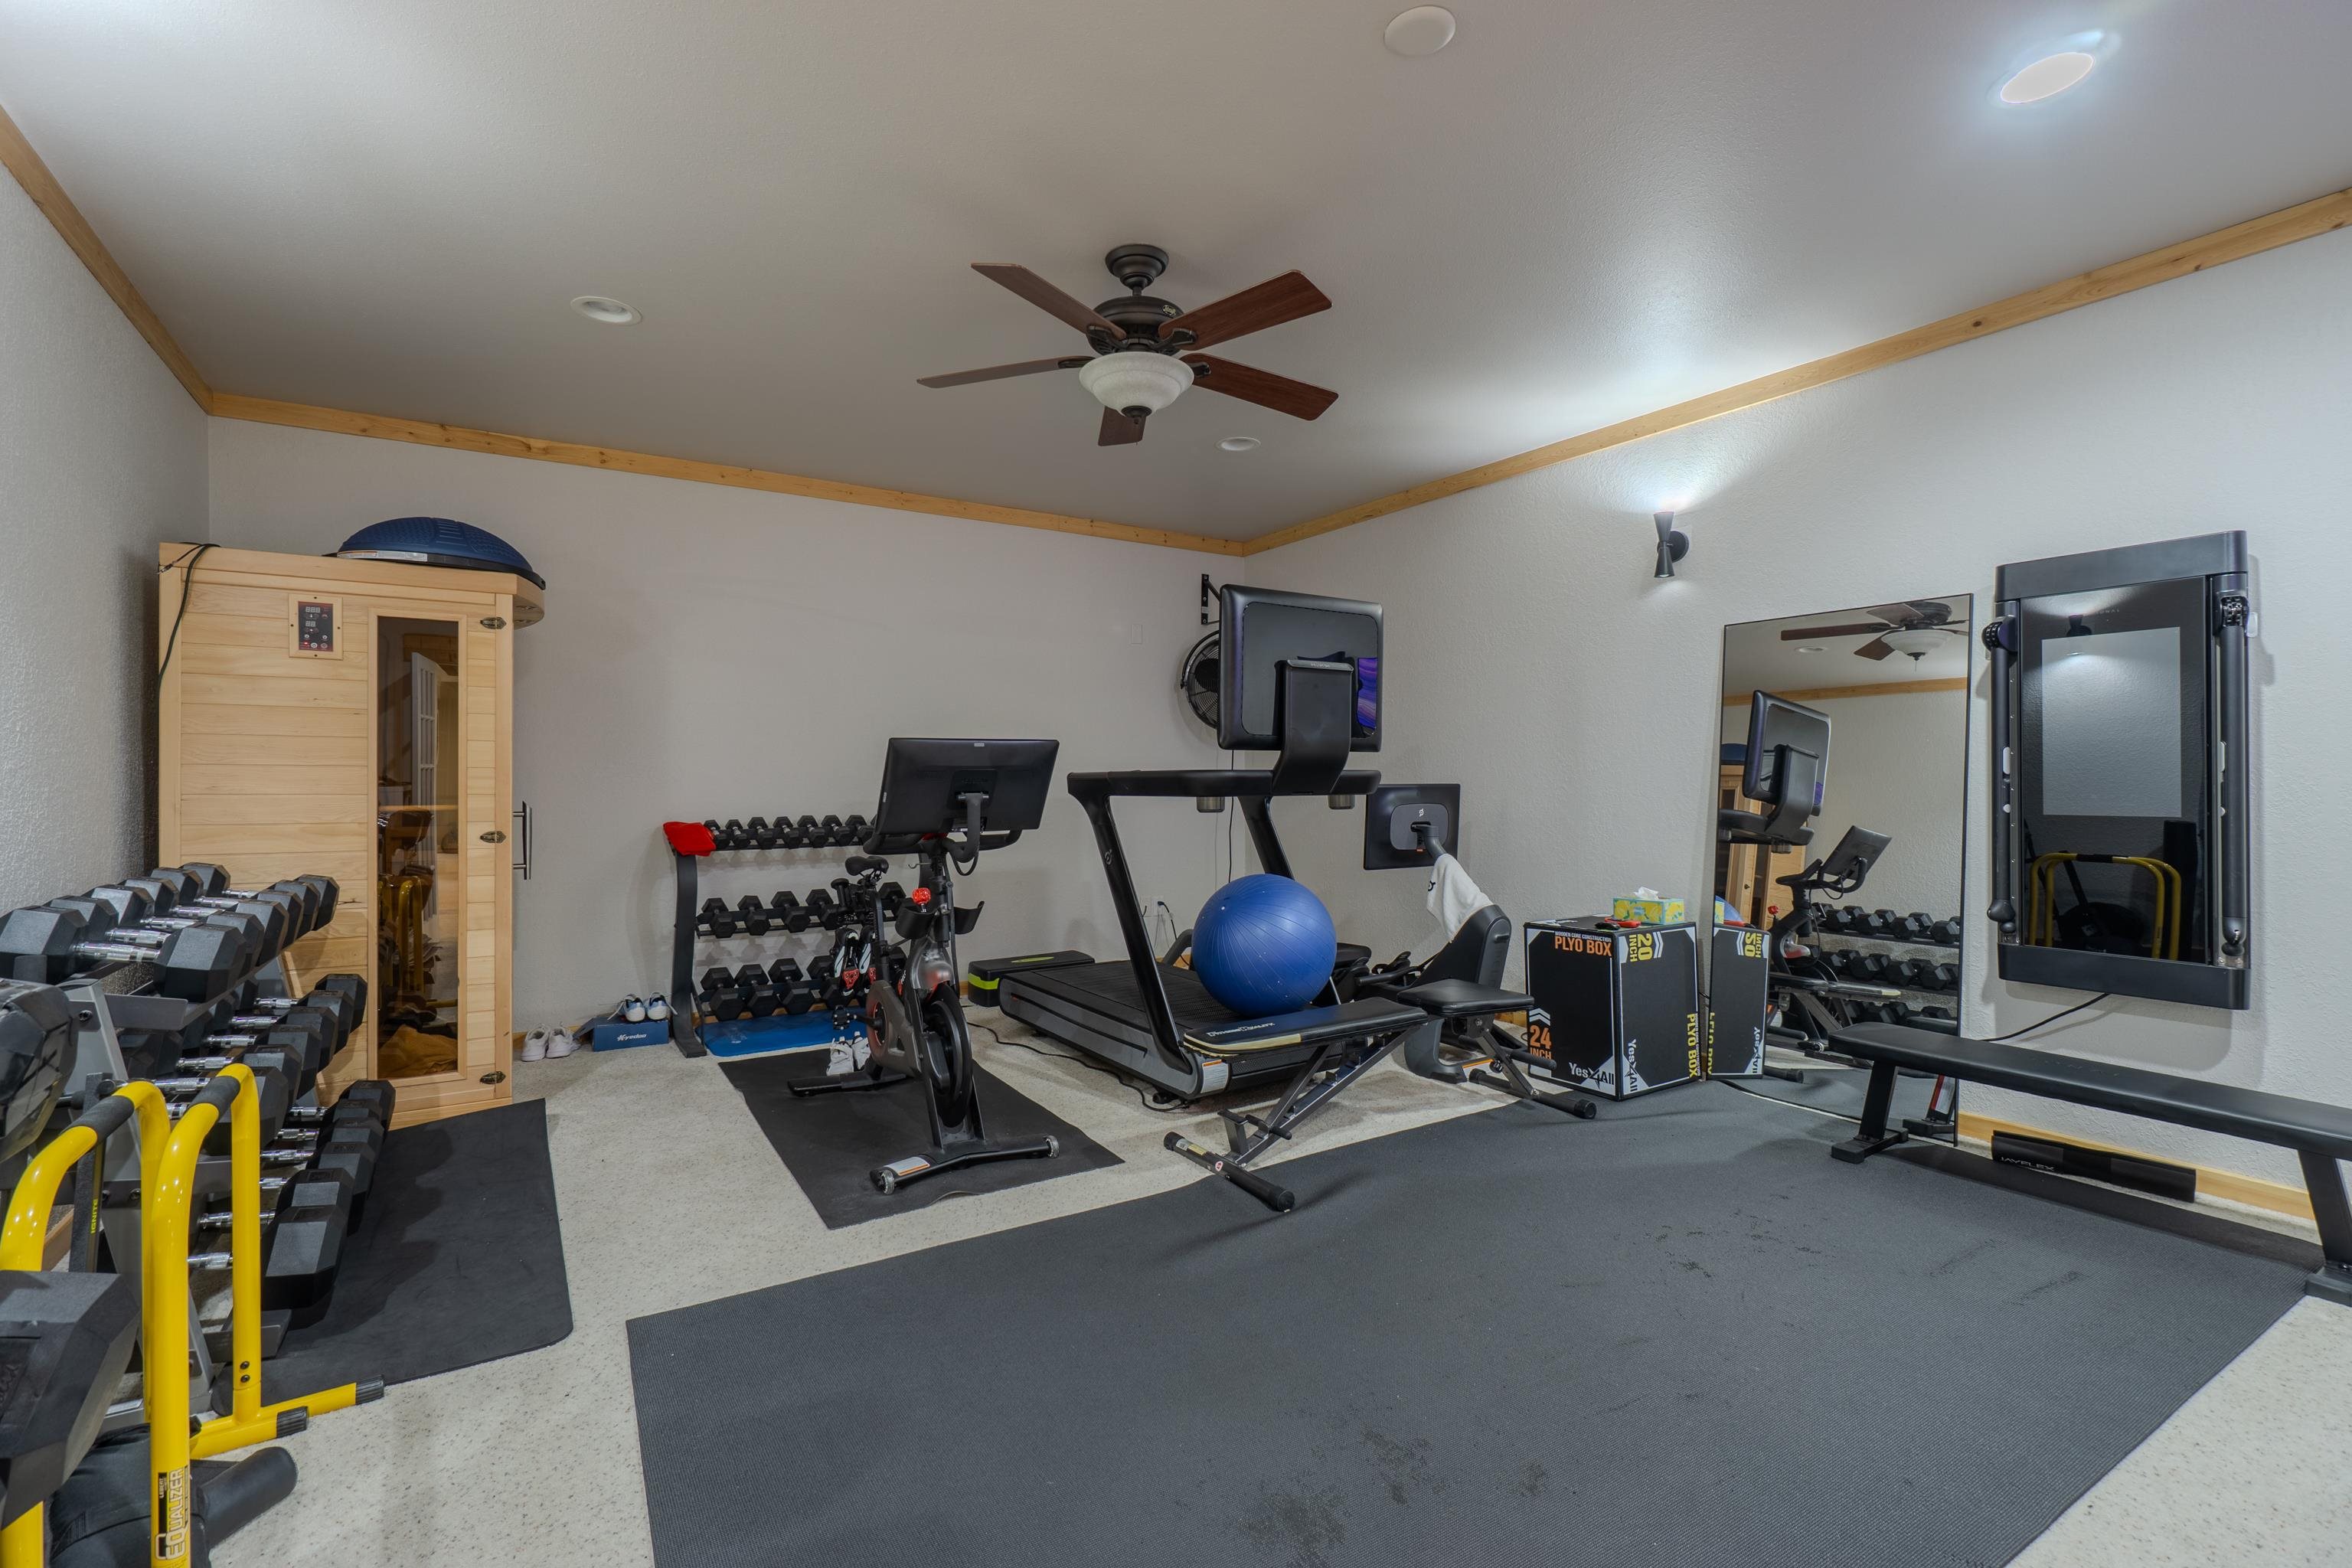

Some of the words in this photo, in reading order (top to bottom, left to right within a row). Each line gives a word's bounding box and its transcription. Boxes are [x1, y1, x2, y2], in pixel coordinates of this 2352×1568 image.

[1555, 936, 1583, 952] PLYO
[1586, 939, 1612, 956] BOX
[1629, 934, 1638, 962] INCH
[1638, 933, 1653, 961] 20
[1530, 1024, 1552, 1049] 24
[1687, 1013, 1697, 1047] PLYO
[1530, 1047, 1552, 1060] INCH
[1625, 1038, 1638, 1092] Yes4All
[1688, 1050, 1697, 1078] BOX
[1569, 1061, 1615, 1089] Yes4All
[165, 1468, 185, 1560] EQUALIZER
